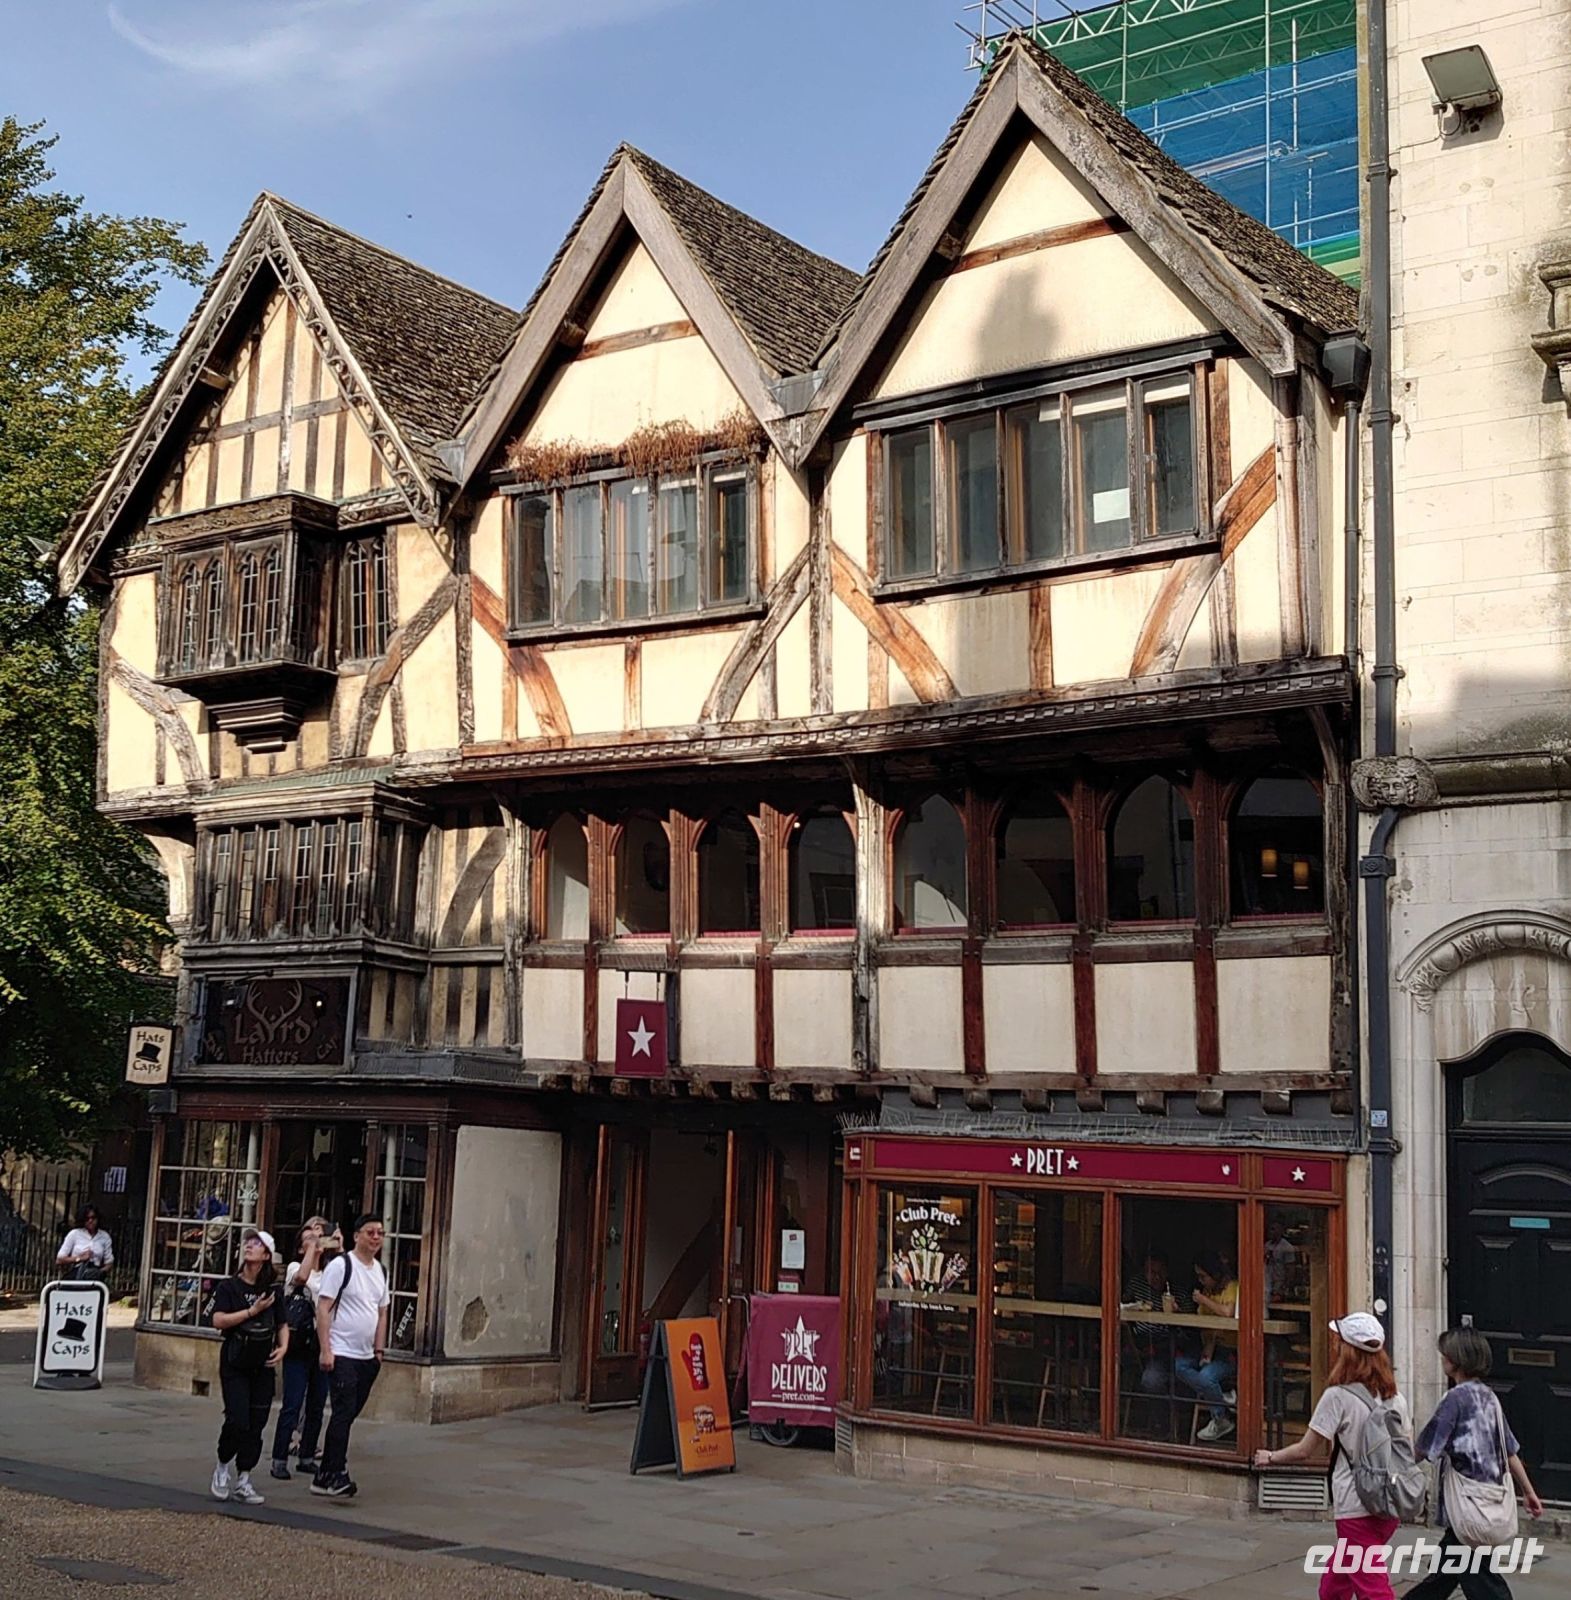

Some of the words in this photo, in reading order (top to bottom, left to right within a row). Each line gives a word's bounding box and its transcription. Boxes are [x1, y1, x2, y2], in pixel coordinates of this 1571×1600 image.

[136, 1031, 165, 1043] Hats
[242, 1045, 300, 1065] Hatters
[132, 1060, 162, 1074] Caps
[1026, 1147, 1064, 1175] PRET
[900, 1206, 929, 1223] Club
[930, 1206, 957, 1226] Pret
[56, 1302, 93, 1316] Hats
[52, 1341, 90, 1358] Caps
[784, 1328, 817, 1357] PRET
[771, 1362, 828, 1392] DELIVERS
[782, 1392, 815, 1402] pret.com
